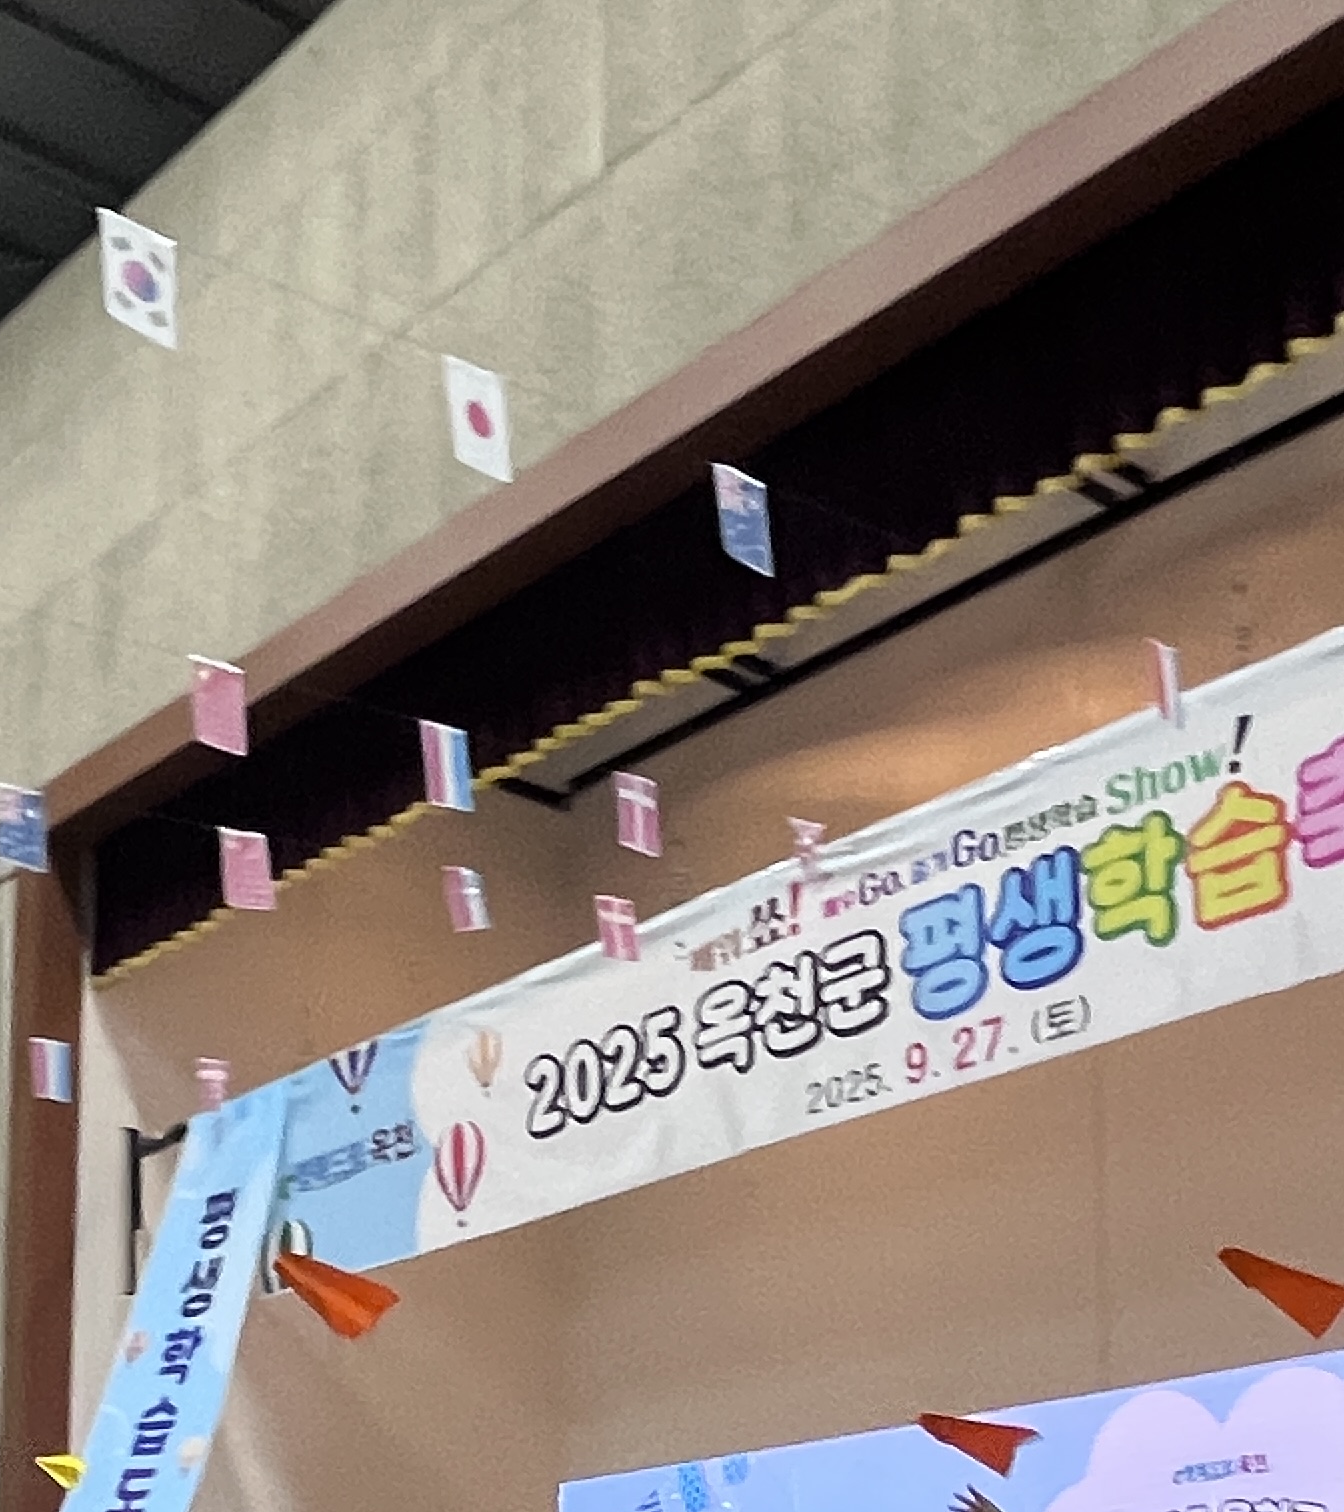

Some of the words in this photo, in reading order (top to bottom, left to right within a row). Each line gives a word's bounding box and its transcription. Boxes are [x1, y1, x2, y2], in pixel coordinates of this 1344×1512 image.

[1104, 714, 1254, 815] Show!
[524, 1010, 688, 1139] 2025
[694, 928, 894, 1074] 옥천군
[1030, 994, 1092, 1044] (토)
